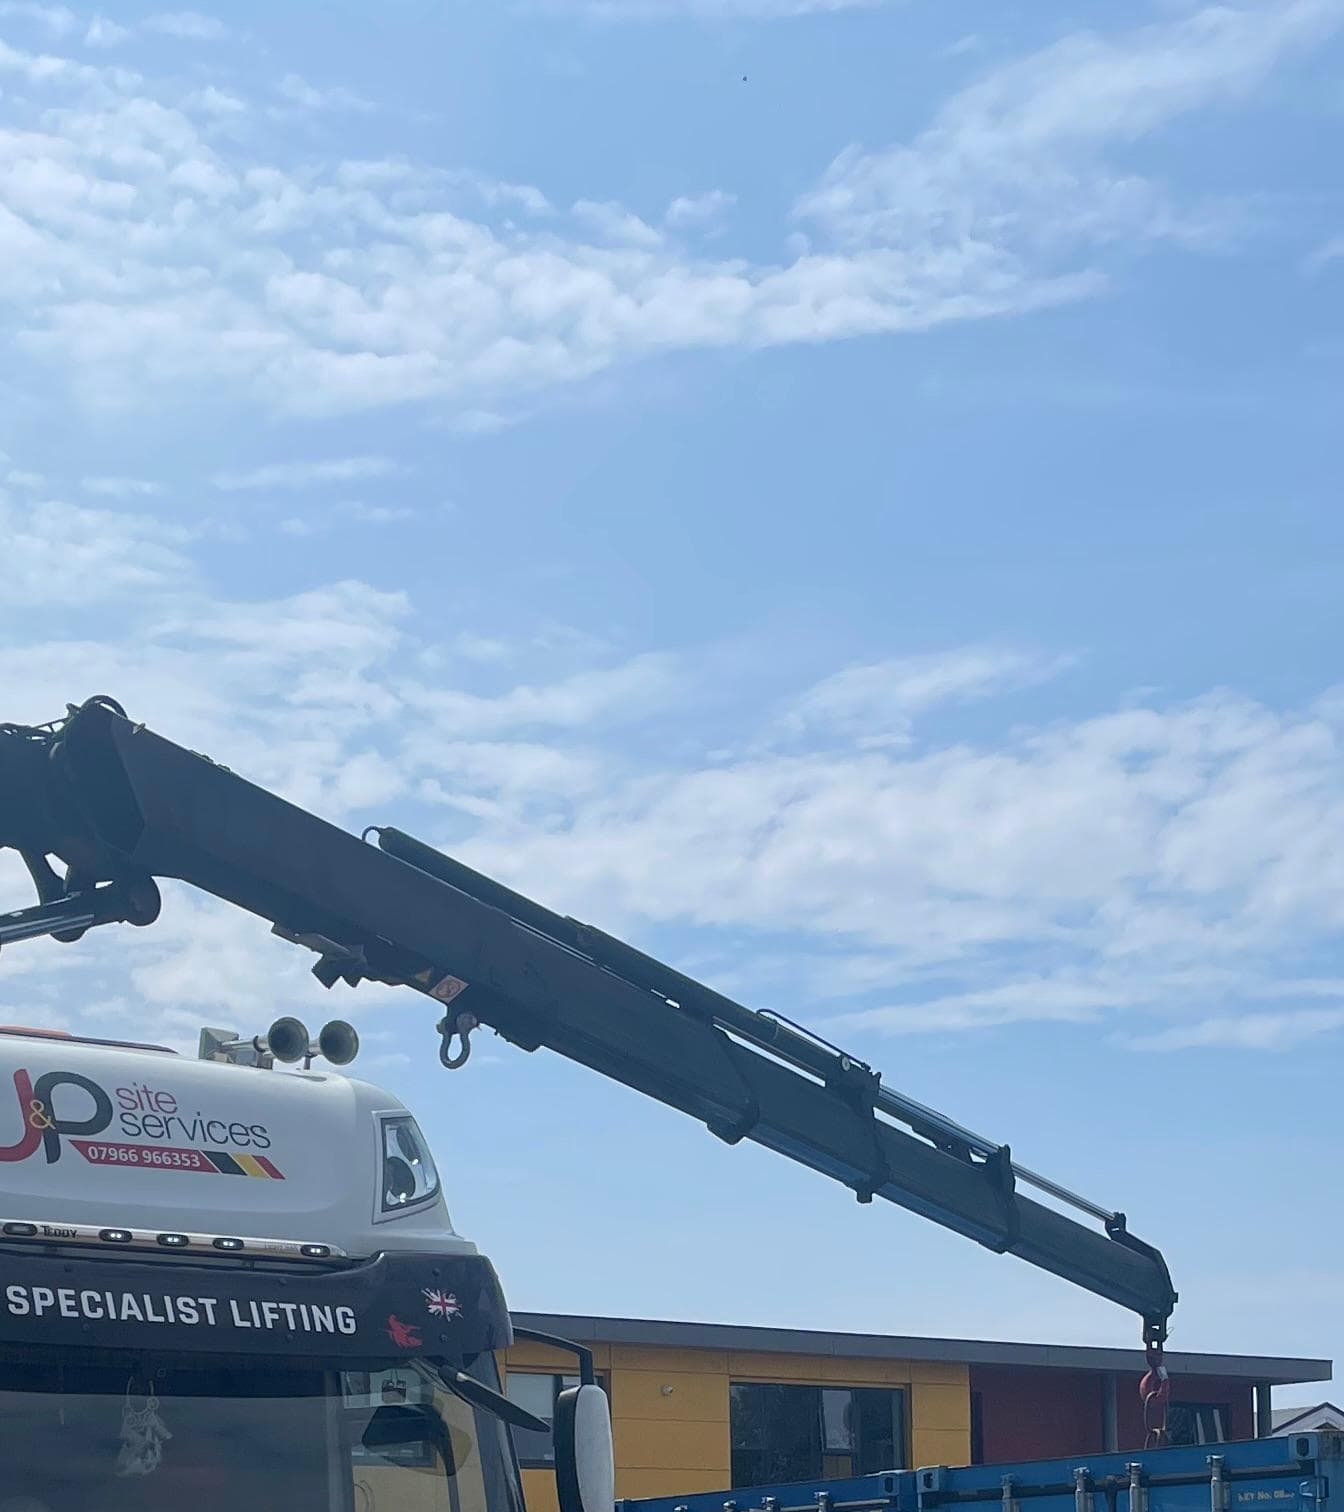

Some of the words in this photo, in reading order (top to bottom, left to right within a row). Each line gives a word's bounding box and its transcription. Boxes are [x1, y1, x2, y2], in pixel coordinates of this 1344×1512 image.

[115, 1082, 177, 1114] site
[120, 1111, 271, 1149] services
[87, 1146, 139, 1163] 07966
[142, 1148, 201, 1167] 966353
[6, 1285, 217, 1326] SPECIALIST
[229, 1299, 356, 1335] LIFTING
